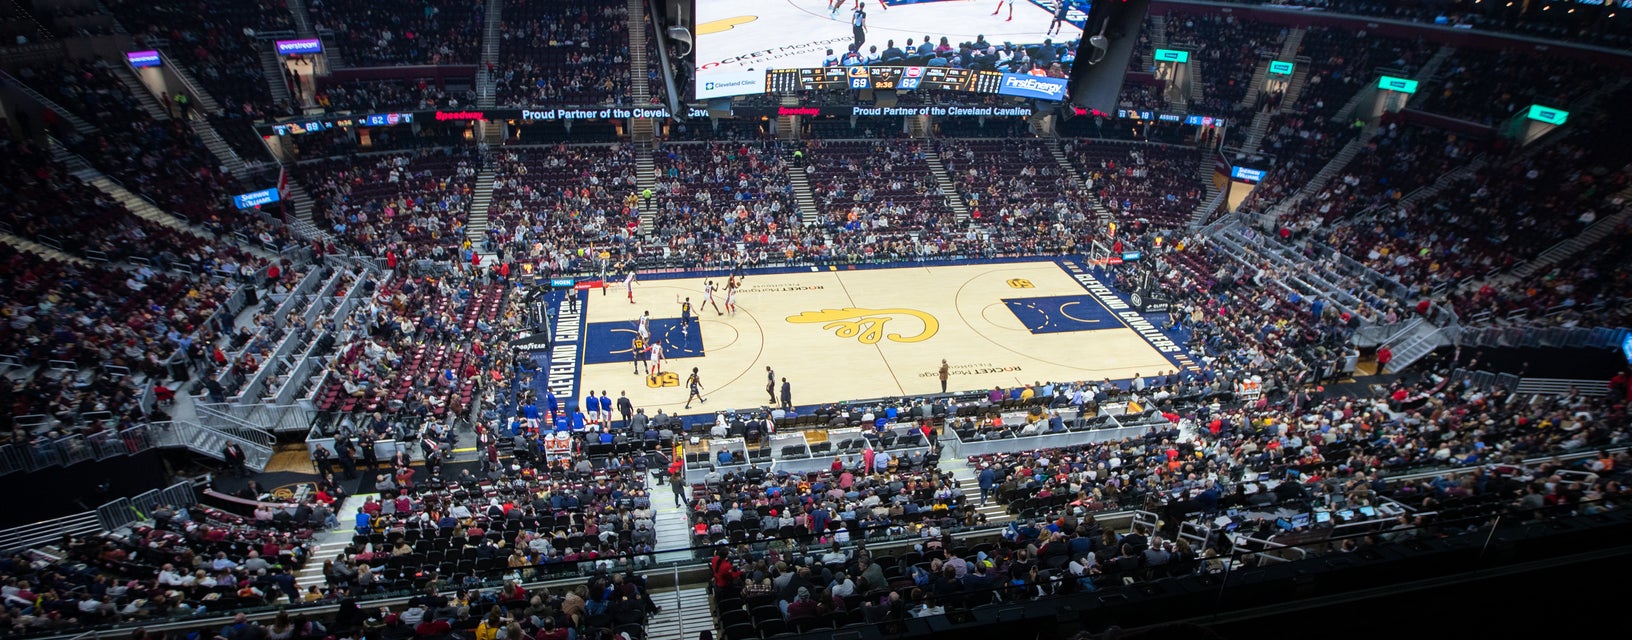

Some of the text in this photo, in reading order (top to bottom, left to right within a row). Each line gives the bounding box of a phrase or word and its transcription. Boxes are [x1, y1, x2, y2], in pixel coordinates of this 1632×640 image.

[852, 78, 867, 88] 69
[902, 78, 916, 88] 62
[1006, 77, 1061, 93] FirstEnergy
[435, 111, 483, 121] Speedway
[522, 108, 671, 119] Proud Partner of the Clevela
[778, 106, 819, 116] Speedway
[852, 106, 881, 115] Proud
[883, 106, 918, 116] Partner
[919, 106, 930, 115] of
[931, 106, 946, 115] the
[948, 106, 992, 116] Cleveland
[371, 116, 384, 125] 62
[305, 121, 318, 131] 69
[1074, 273, 1130, 309] CLEVELAND
[1118, 311, 1182, 352] CAVALIERS
[548, 344, 577, 398] CLEVELAND
[974, 365, 1022, 374] ROCKET
